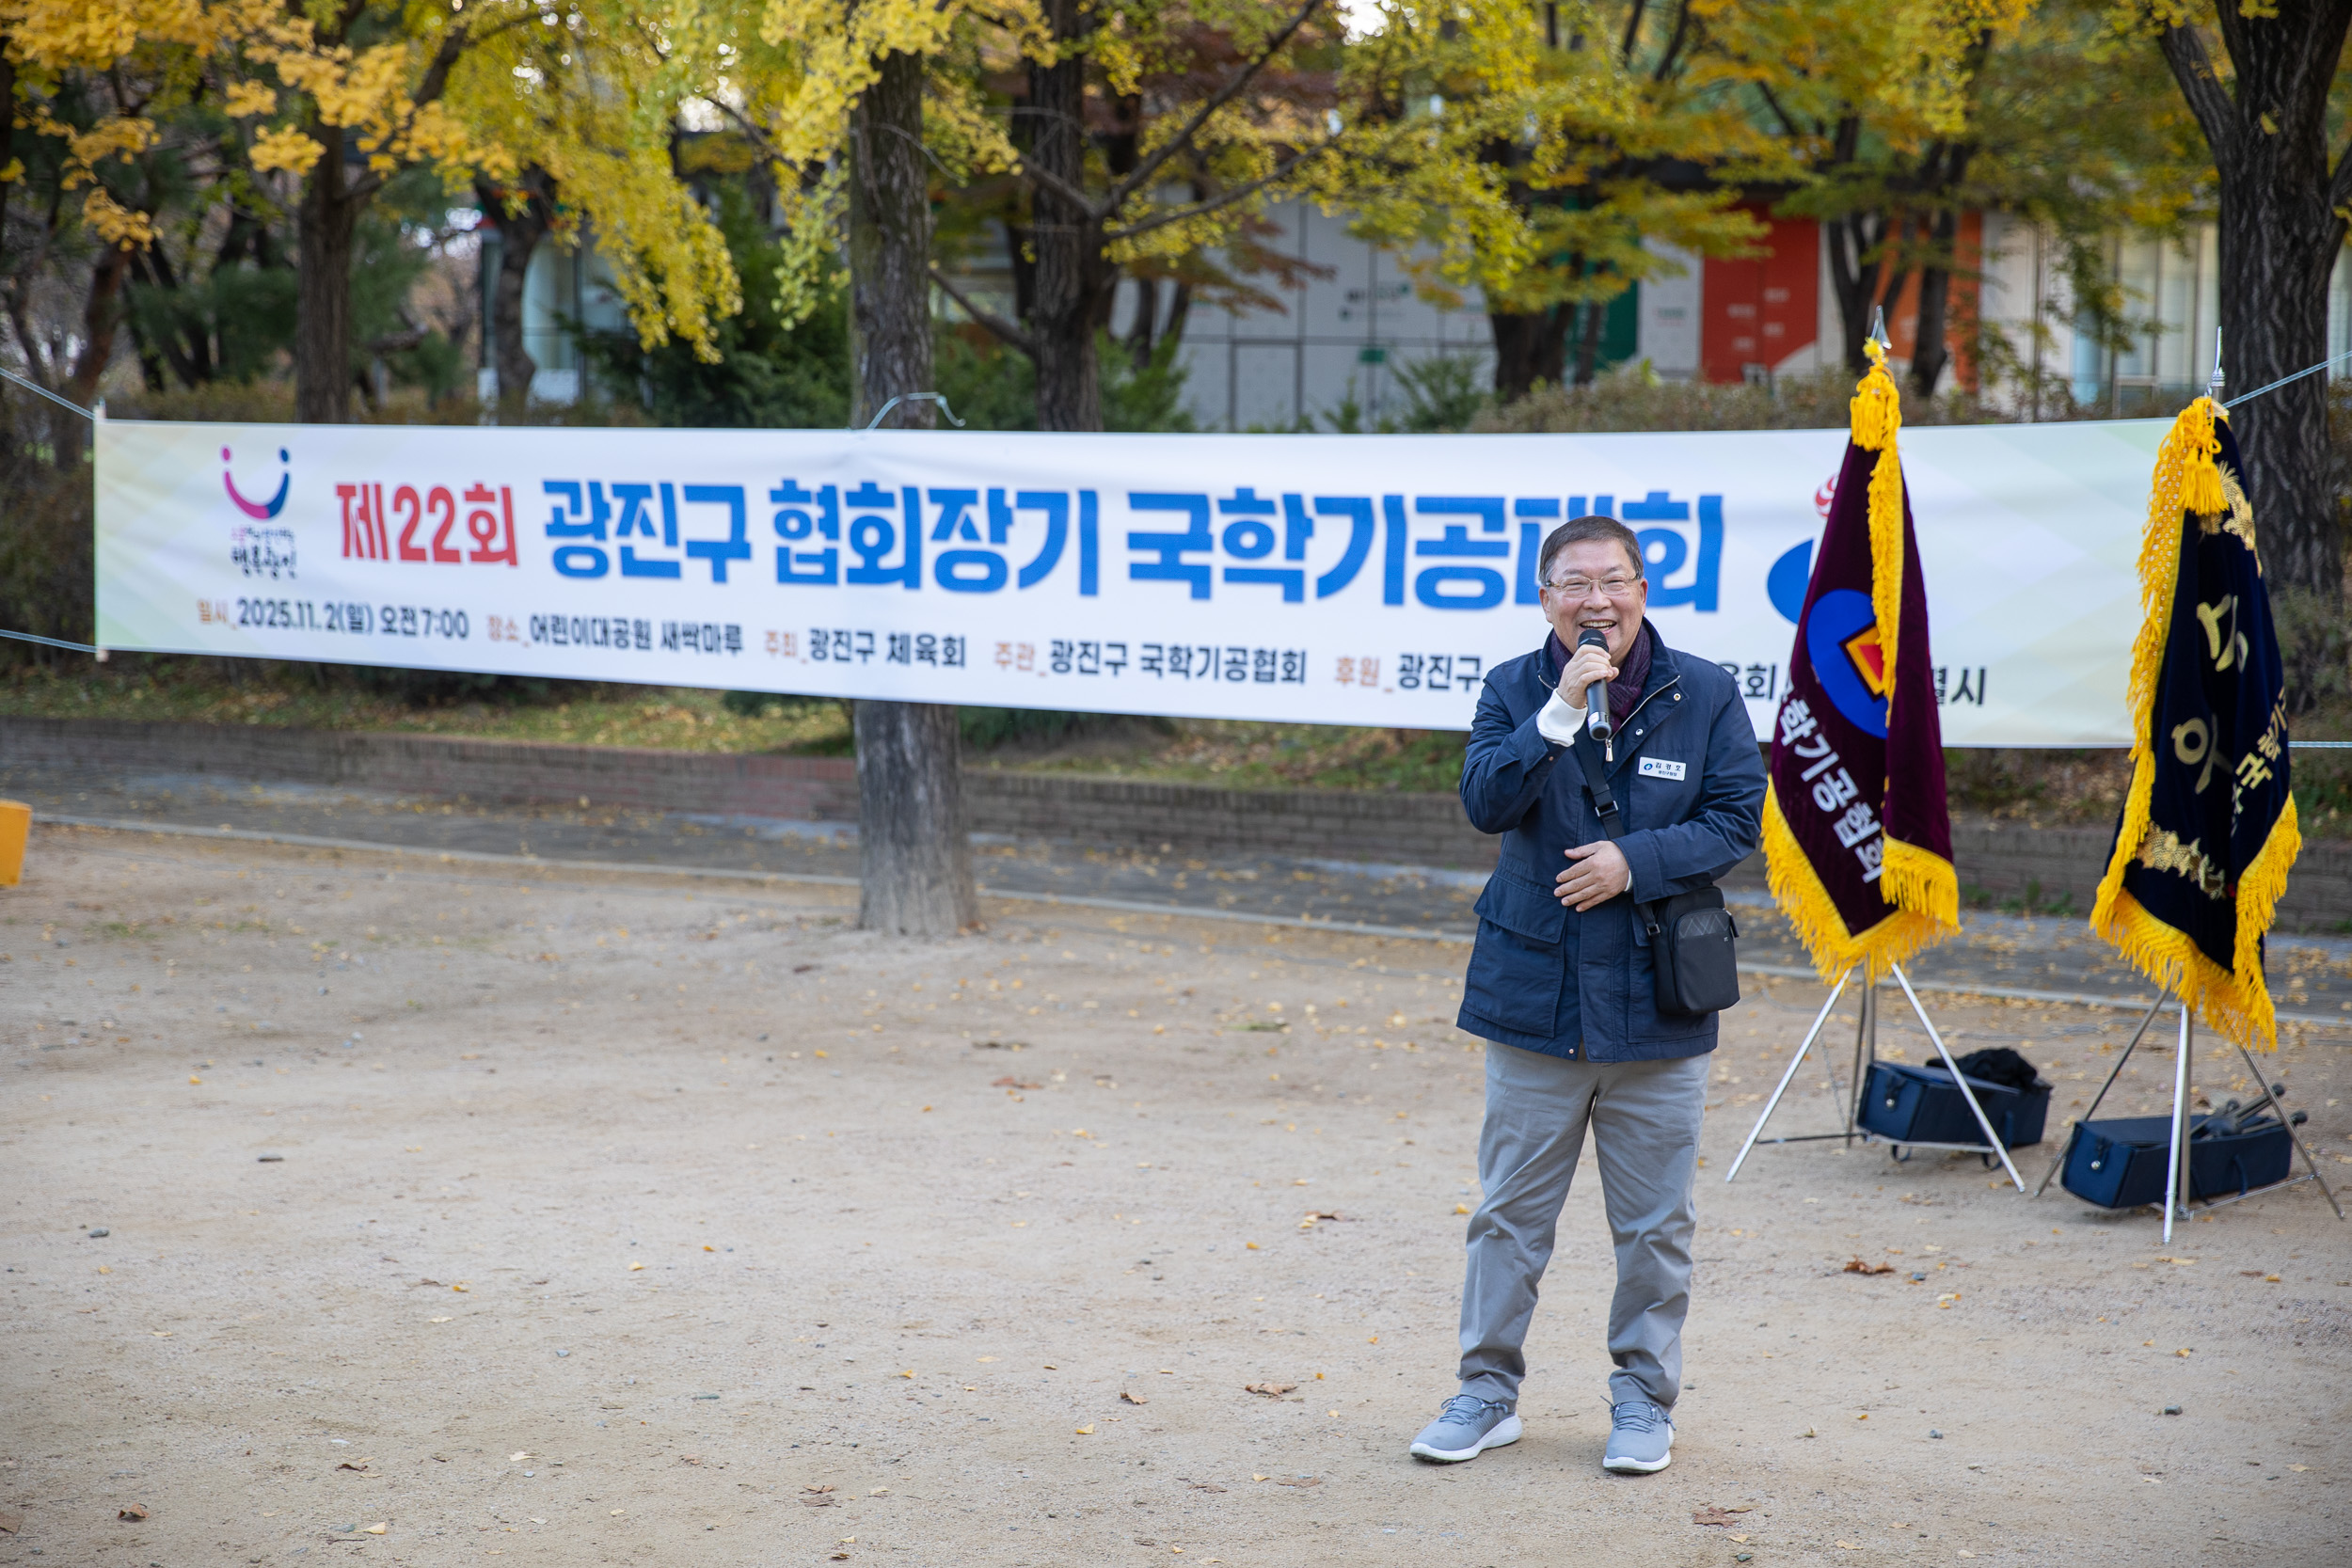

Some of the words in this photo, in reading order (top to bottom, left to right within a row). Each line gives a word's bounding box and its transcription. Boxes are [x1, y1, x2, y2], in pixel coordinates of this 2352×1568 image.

[336, 482, 519, 568] 제22회
[541, 478, 753, 583] 광진구
[769, 478, 1099, 597] 협회장기
[886, 631, 966, 669] 체육회
[1140, 641, 1307, 685] 국학기공협회
[1779, 672, 1885, 884] 학기공협회
